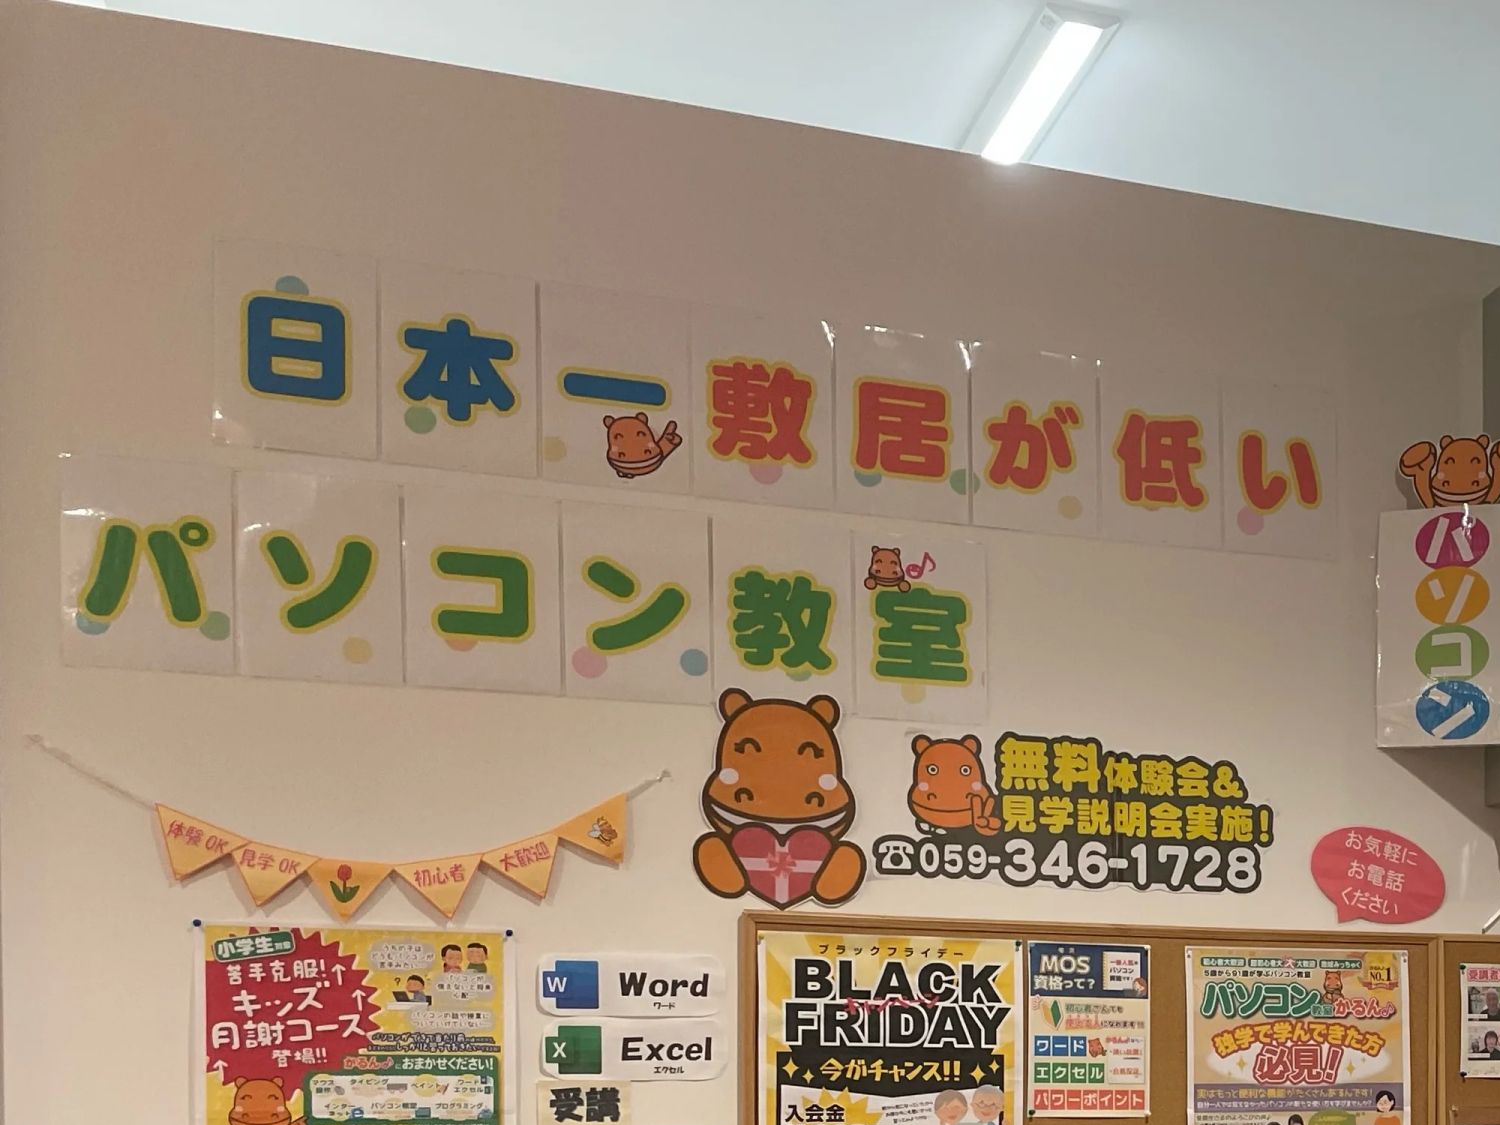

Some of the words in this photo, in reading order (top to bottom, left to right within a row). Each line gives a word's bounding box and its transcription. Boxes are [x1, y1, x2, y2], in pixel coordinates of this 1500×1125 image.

[242, 291, 1321, 511] 日本一敷居が低い
[80, 519, 972, 684] パソコン教室
[1420, 515, 1485, 739] パソコン
[999, 736, 1244, 800] 無料体験会&
[1000, 794, 1271, 842] 見学説明会実施!
[167, 819, 204, 844] 体験
[205, 835, 230, 854] OK
[1344, 830, 1419, 866] お気軽に
[240, 848, 274, 871] 見学
[278, 857, 302, 875] OK
[499, 841, 550, 871] 大歓迎
[920, 839, 1258, 889] 059-346-1728
[413, 864, 467, 888] 初心者
[1348, 859, 1406, 894] お電話
[1340, 886, 1399, 918] ください
[819, 944, 964, 958] ブラックフライデー
[1039, 955, 1091, 974] MOS
[226, 959, 327, 984] 苦手克服!
[547, 977, 567, 993] W
[619, 972, 710, 997] Word
[794, 959, 1002, 1003] BLACK
[1033, 975, 1096, 991] 資格って?
[232, 980, 330, 1017] キッズ
[1201, 980, 1321, 1019] パソコン
[1311, 1005, 1333, 1016] 教室
[1335, 999, 1380, 1017] かるん
[212, 1013, 367, 1049] 月謝コース
[785, 1002, 1011, 1048] FRIDAY
[272, 1049, 328, 1068] 登場!!
[553, 1042, 566, 1058] X
[621, 1036, 713, 1062] Excel
[1036, 1039, 1084, 1053] ワード
[344, 1058, 380, 1068] かるん
[395, 1058, 494, 1070] におまかせください!
[654, 1066, 684, 1074] エクセル
[820, 1058, 961, 1082] 今がチャンス!!
[1036, 1066, 1103, 1080] エクセル
[1254, 1044, 1343, 1086] 必見!
[549, 1087, 621, 1123] 受講
[785, 1104, 845, 1122] 入会金
[1036, 1092, 1143, 1107] パワーポイント
